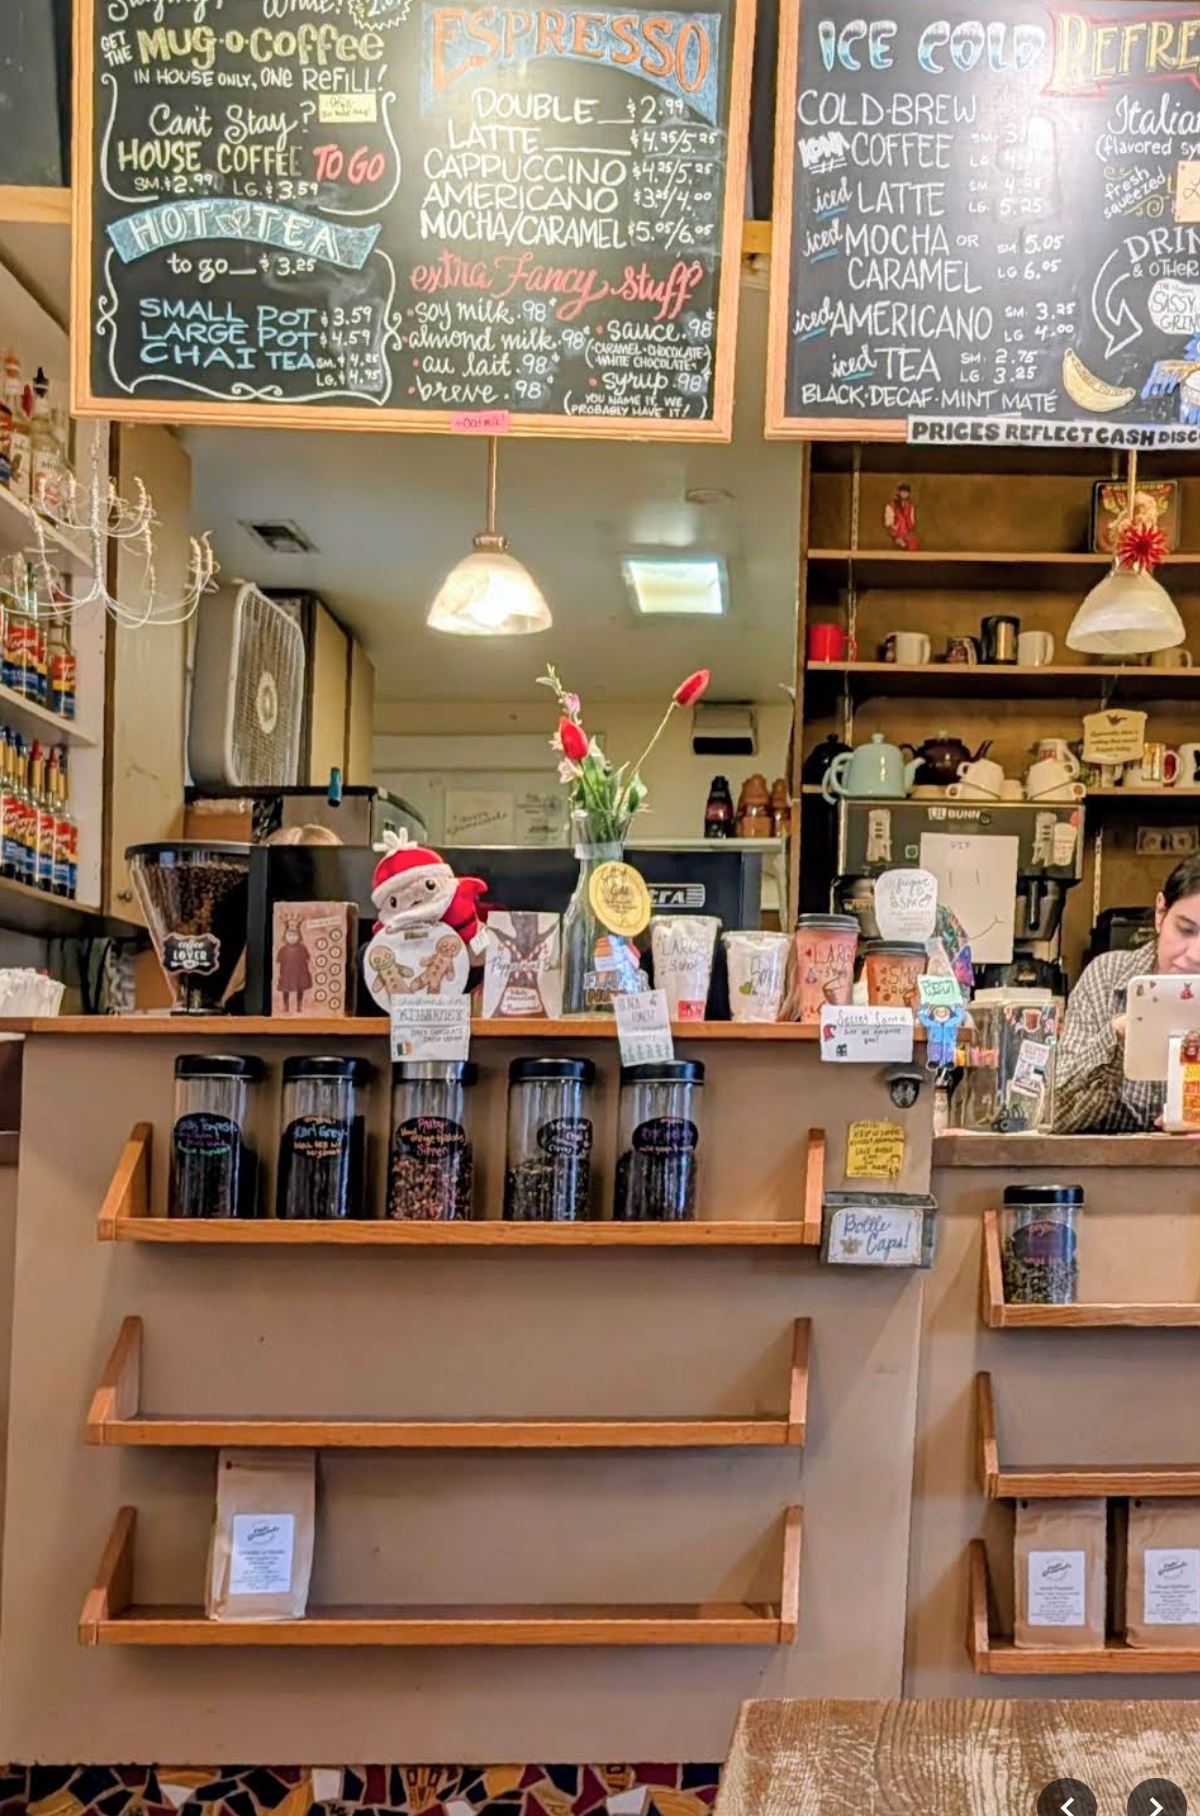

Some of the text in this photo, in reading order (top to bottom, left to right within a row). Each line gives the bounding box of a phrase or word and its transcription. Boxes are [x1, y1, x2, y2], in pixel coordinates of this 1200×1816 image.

[101, 30, 127, 52] GET
[104, 48, 133, 67] THE
[431, 7, 712, 95] ESPRESSO
[817, 19, 898, 73] ICE
[917, 19, 1046, 74] COLD
[157, 69, 214, 86] HOUSE
[471, 88, 598, 125] DOUBLE
[449, 117, 541, 154] LATTE
[850, 131, 953, 170] COFFEE
[117, 138, 386, 184] HOUSE COFFEE TO GO
[423, 147, 627, 187] CAPPUCCINO
[422, 181, 619, 214] AMERICANO
[857, 178, 945, 217] LATTE
[1103, 166, 1166, 220] squeezed
[1104, 166, 1150, 201] fresh
[129, 202, 342, 263] HOT TEA
[420, 208, 627, 249] MOCHA/CARAMEL
[844, 223, 950, 257] MOCHA
[956, 235, 980, 248] OR
[167, 252, 228, 284] to go
[410, 250, 493, 293] extra
[848, 256, 982, 293] CARAMEL
[139, 299, 244, 324] SMALL
[257, 305, 317, 331] POT
[414, 300, 452, 332] soy
[1150, 290, 1196, 314] SASSY
[141, 321, 317, 349] LARGE POT
[829, 299, 994, 342] AMERICANO
[409, 327, 494, 351] almond
[139, 342, 317, 372] CHAI TEA
[422, 352, 512, 377] au lait
[874, 345, 941, 383] TEA
[416, 368, 498, 403] breve
[602, 371, 669, 396] syrup
[911, 421, 1000, 442] PRICES
[1005, 422, 1094, 443] REFLECT
[1095, 427, 1155, 446] CASH
[947, 809, 981, 820] BUNN
